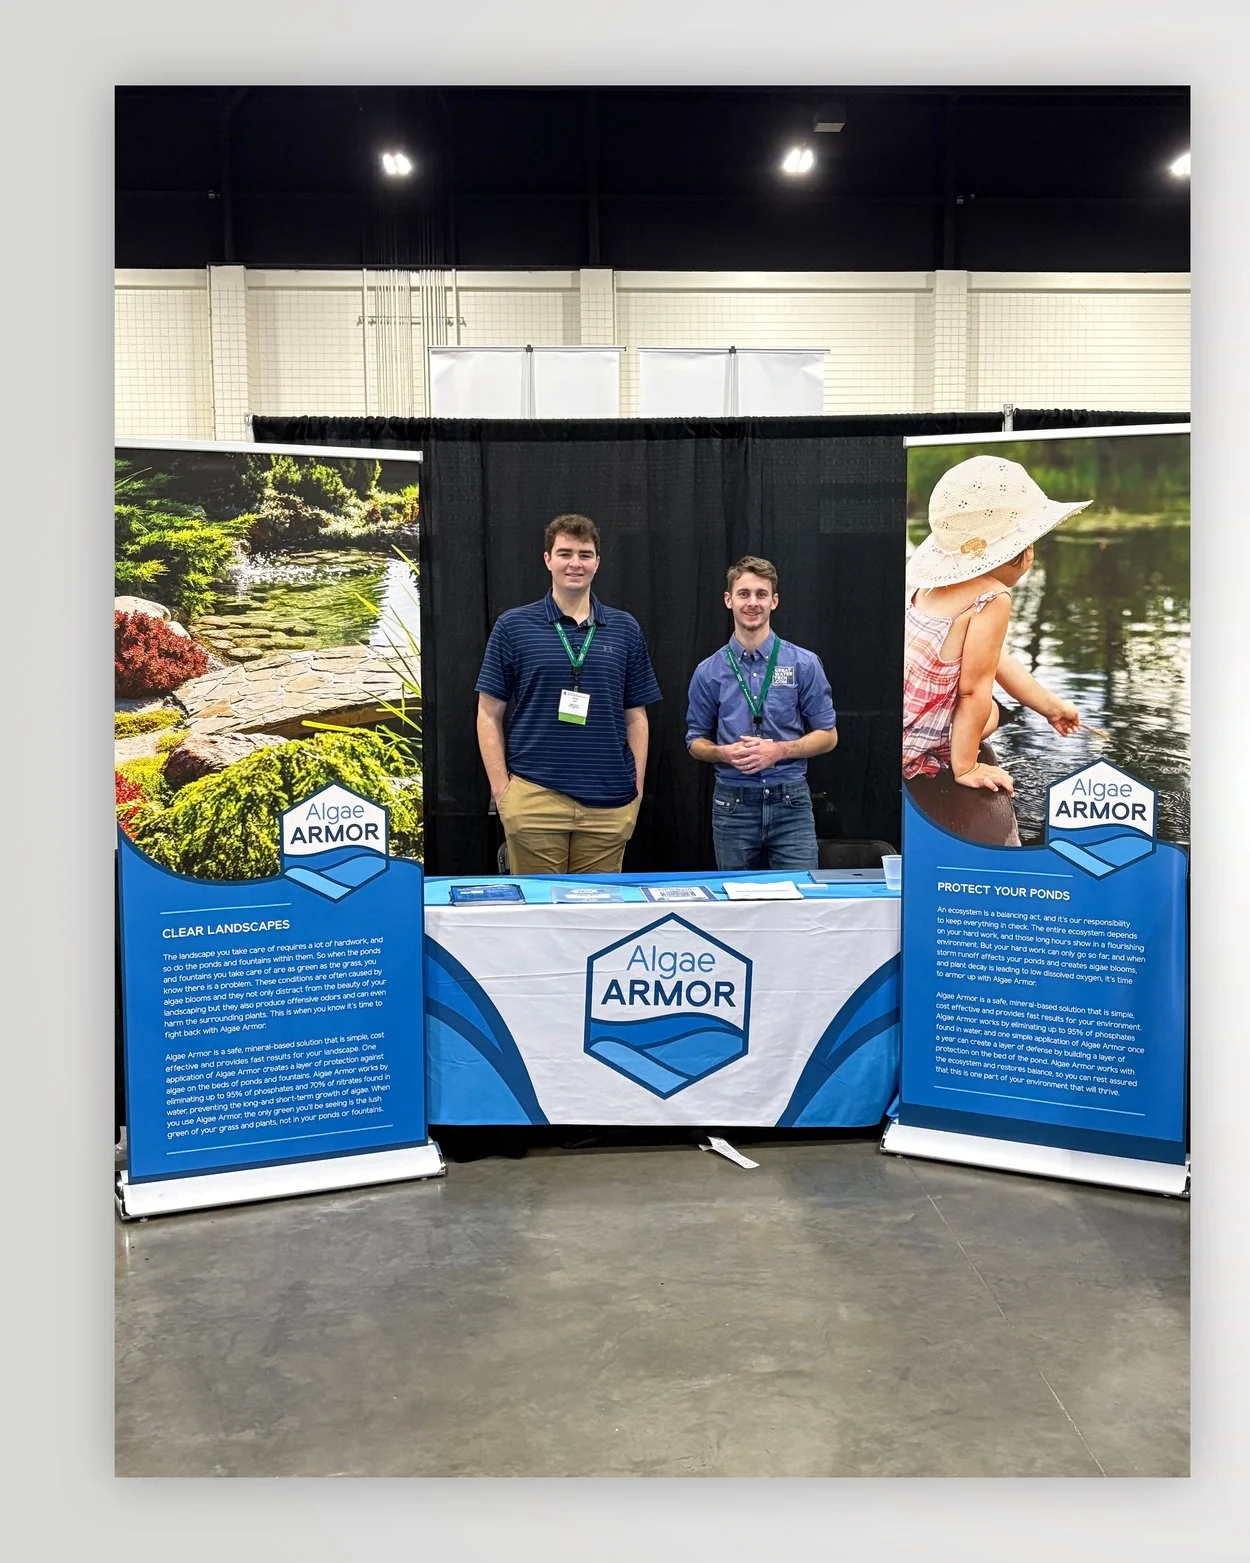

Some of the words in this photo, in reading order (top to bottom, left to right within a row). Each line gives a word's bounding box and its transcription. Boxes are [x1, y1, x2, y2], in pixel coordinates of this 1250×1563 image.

[1071, 778, 1132, 801] Algae
[306, 802, 364, 825] Algae
[1055, 800, 1147, 821] ARMOR
[290, 823, 380, 845] ARMOR
[937, 881, 991, 895] PROTECT
[994, 885, 1027, 897] YOUR
[1029, 887, 1070, 901] PONDS
[162, 925, 204, 939] CLEAR
[207, 918, 290, 935] LANDSCAPES
[936, 916, 944, 924] to
[945, 917, 962, 926] keep
[962, 919, 999, 930] everything
[1031, 923, 1045, 932] The
[1045, 926, 1066, 934] entire
[1067, 928, 1105, 937] ecosystem
[1106, 930, 1137, 940] depends
[163, 952, 178, 961] The
[178, 950, 216, 960] landscape
[216, 949, 230, 958] you
[231, 947, 248, 955] take
[248, 946, 266, 954] care
[267, 944, 275, 953] of
[276, 943, 307, 952] requires
[314, 940, 323, 948] lot
[324, 939, 333, 948] of
[370, 936, 383, 944] and
[936, 948, 957, 957] storm
[957, 950, 979, 959] runoff
[980, 952, 1005, 961] affects
[1006, 955, 1022, 963] your
[1023, 957, 1045, 965] ponds
[1046, 959, 1060, 967] and
[1060, 960, 1088, 969] creates
[1088, 962, 1109, 972] algae
[626, 945, 716, 979] Algae
[163, 986, 183, 994] know
[184, 984, 205, 992] there
[254, 978, 277, 986] These
[277, 974, 313, 984] conditions
[314, 973, 327, 981] are
[328, 971, 347, 979] often
[348, 968, 373, 977] caused
[373, 968, 382, 976] by
[600, 979, 736, 1007] ARMOR
[935, 1002, 950, 1010] cost
[951, 1003, 981, 1013] effective
[981, 1007, 994, 1015] and
[995, 1009, 1025, 1018] provides
[1026, 1011, 1040, 1020] fast
[1040, 1014, 1064, 1023] results
[1065, 1015, 1077, 1024] for
[1078, 1018, 1095, 1026] your
[165, 1062, 199, 1073] effective
[200, 1059, 215, 1069] and
[215, 1057, 249, 1068] provides
[250, 1055, 265, 1063] fast
[266, 1052, 291, 1061] results
[292, 1050, 304, 1059] for
[305, 1049, 323, 1059] your
[361, 1043, 377, 1051] One
